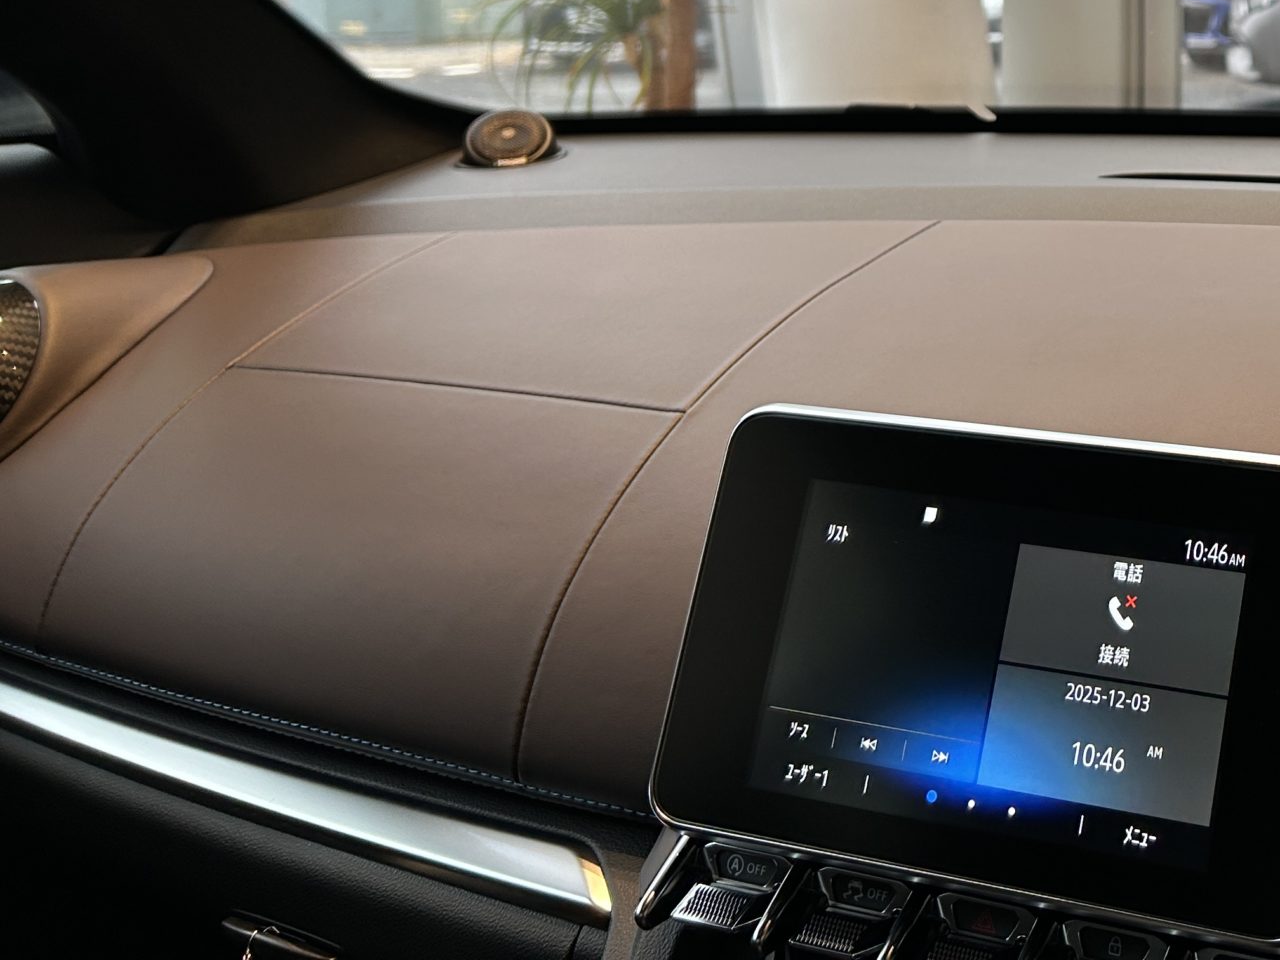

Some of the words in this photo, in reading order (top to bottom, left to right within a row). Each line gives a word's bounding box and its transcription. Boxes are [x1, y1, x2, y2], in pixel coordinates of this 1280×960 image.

[1113, 561, 1144, 584] 電話
[1097, 643, 1131, 668] 接続
[1065, 682, 1151, 713] 2025-12-03
[1071, 741, 1126, 774] 10:46
[1146, 745, 1163, 760] AM
[745, 861, 767, 877] OFF
[866, 886, 889, 902] OFF
